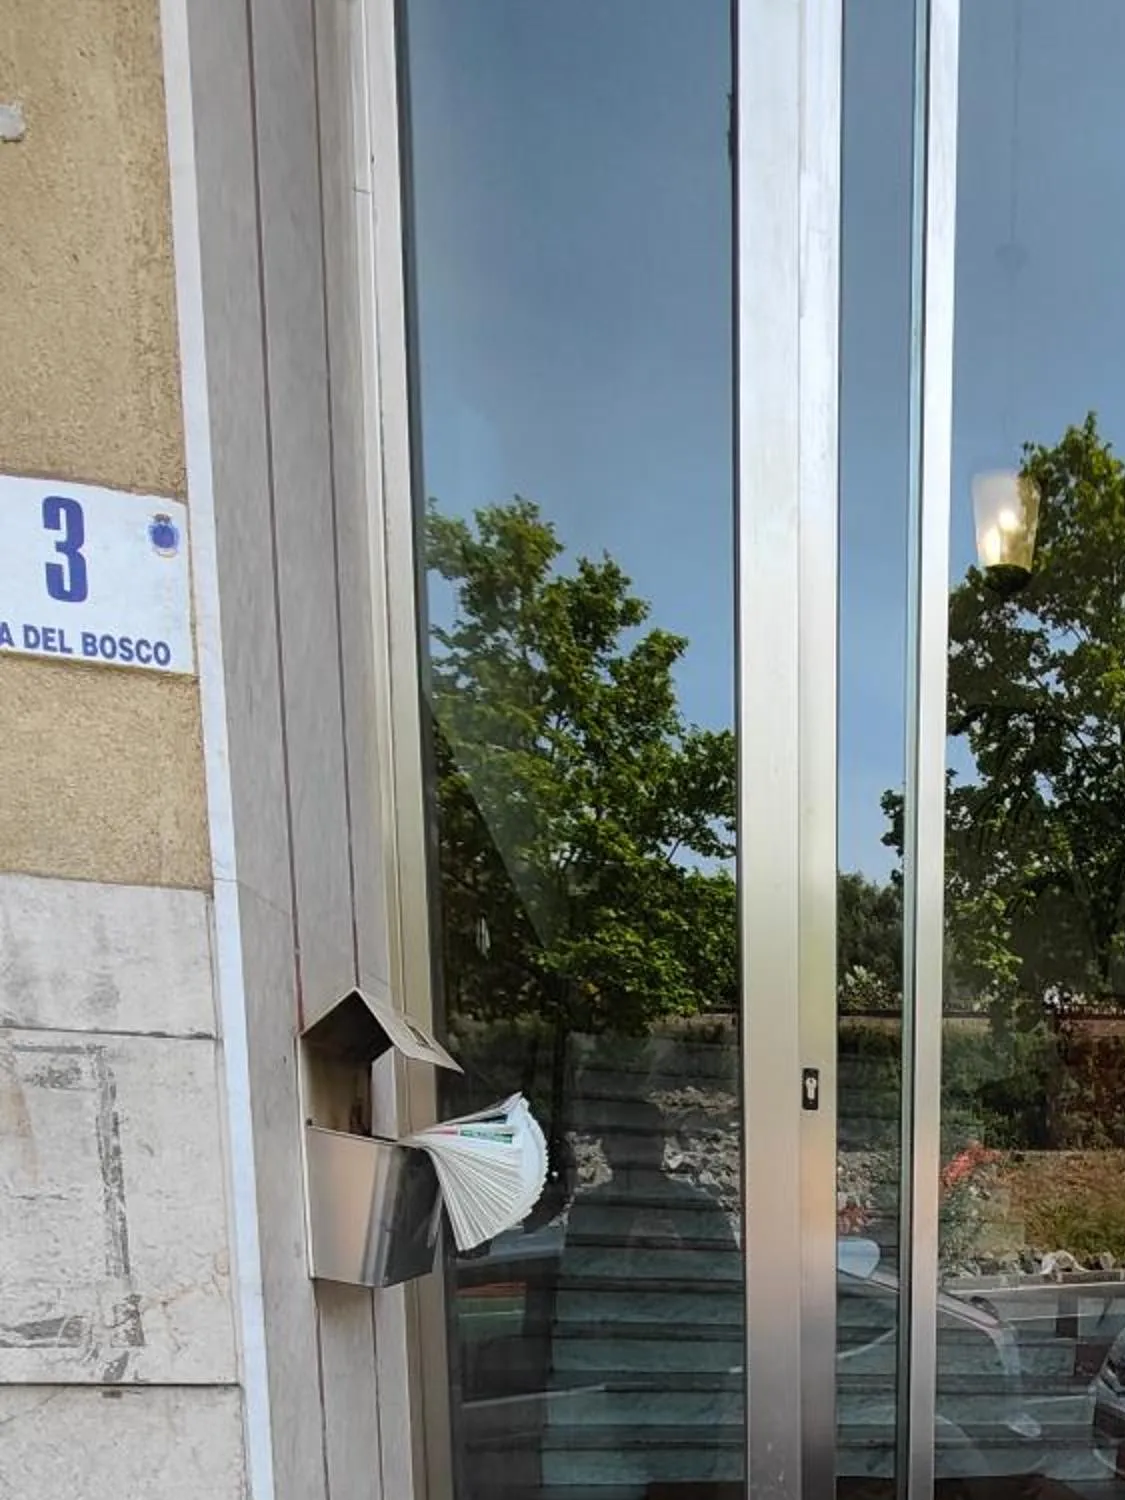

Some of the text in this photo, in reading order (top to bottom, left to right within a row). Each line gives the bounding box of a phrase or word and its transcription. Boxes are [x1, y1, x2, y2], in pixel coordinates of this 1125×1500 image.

[42, 495, 89, 603] 3
[23, 624, 73, 654] DEL
[81, 631, 171, 667] BOSCO
